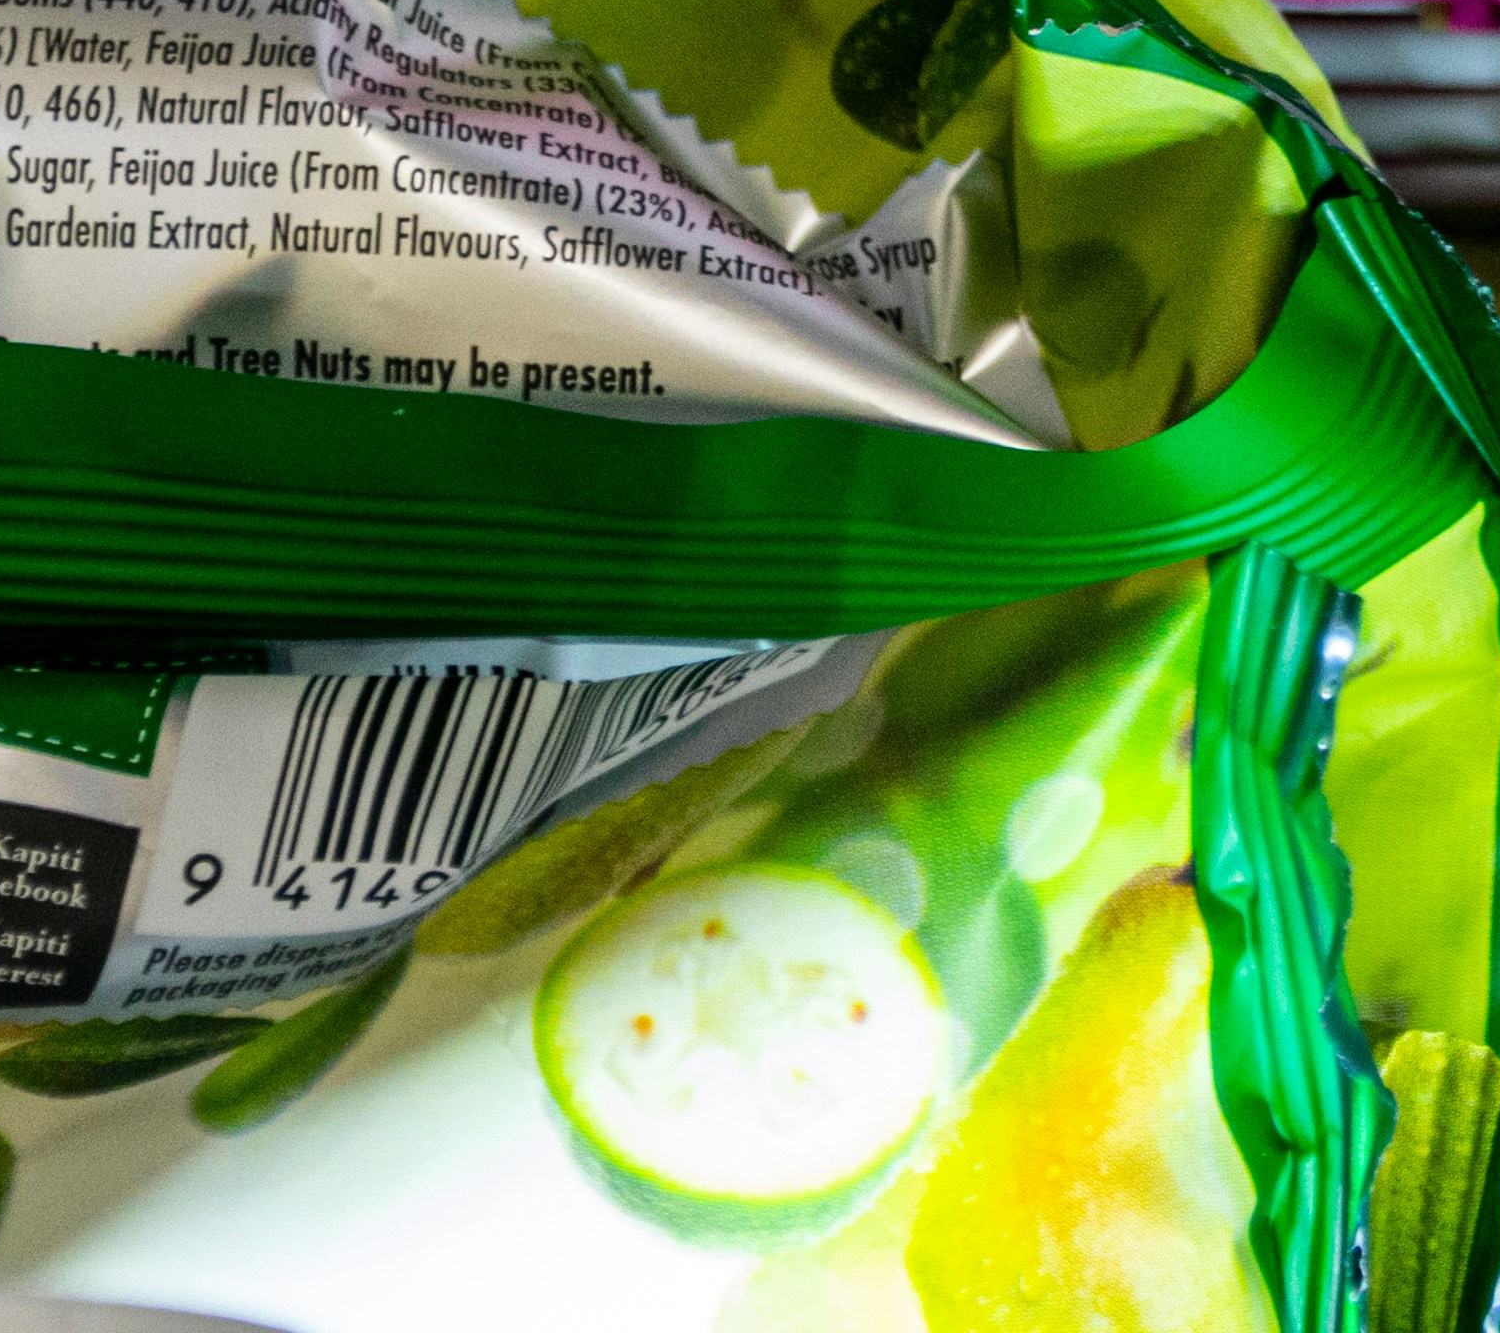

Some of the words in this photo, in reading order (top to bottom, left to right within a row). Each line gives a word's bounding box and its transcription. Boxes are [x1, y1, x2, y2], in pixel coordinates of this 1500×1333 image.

[44, 82, 124, 129] 466),
[137, 85, 247, 127] Natural
[258, 87, 375, 137] Flavour,
[384, 105, 528, 155] Safflower
[6, 145, 96, 194] Sugar,
[108, 147, 194, 197] Feijoa
[204, 148, 279, 188] Juice
[289, 151, 379, 194] (From
[392, 153, 584, 212] Concentrate)
[5, 207, 137, 250] Gardenia
[147, 209, 257, 258] Extract,
[269, 211, 382, 257] Natural
[394, 213, 529, 269] Flavours,
[541, 223, 687, 274] Safflower
[296, 339, 371, 383] Nuts
[383, 351, 453, 394] may
[469, 351, 510, 390] be
[522, 355, 667, 401] present.
[182, 852, 225, 907] 9
[121, 970, 286, 1010] packaging
[142, 943, 248, 977] Please
